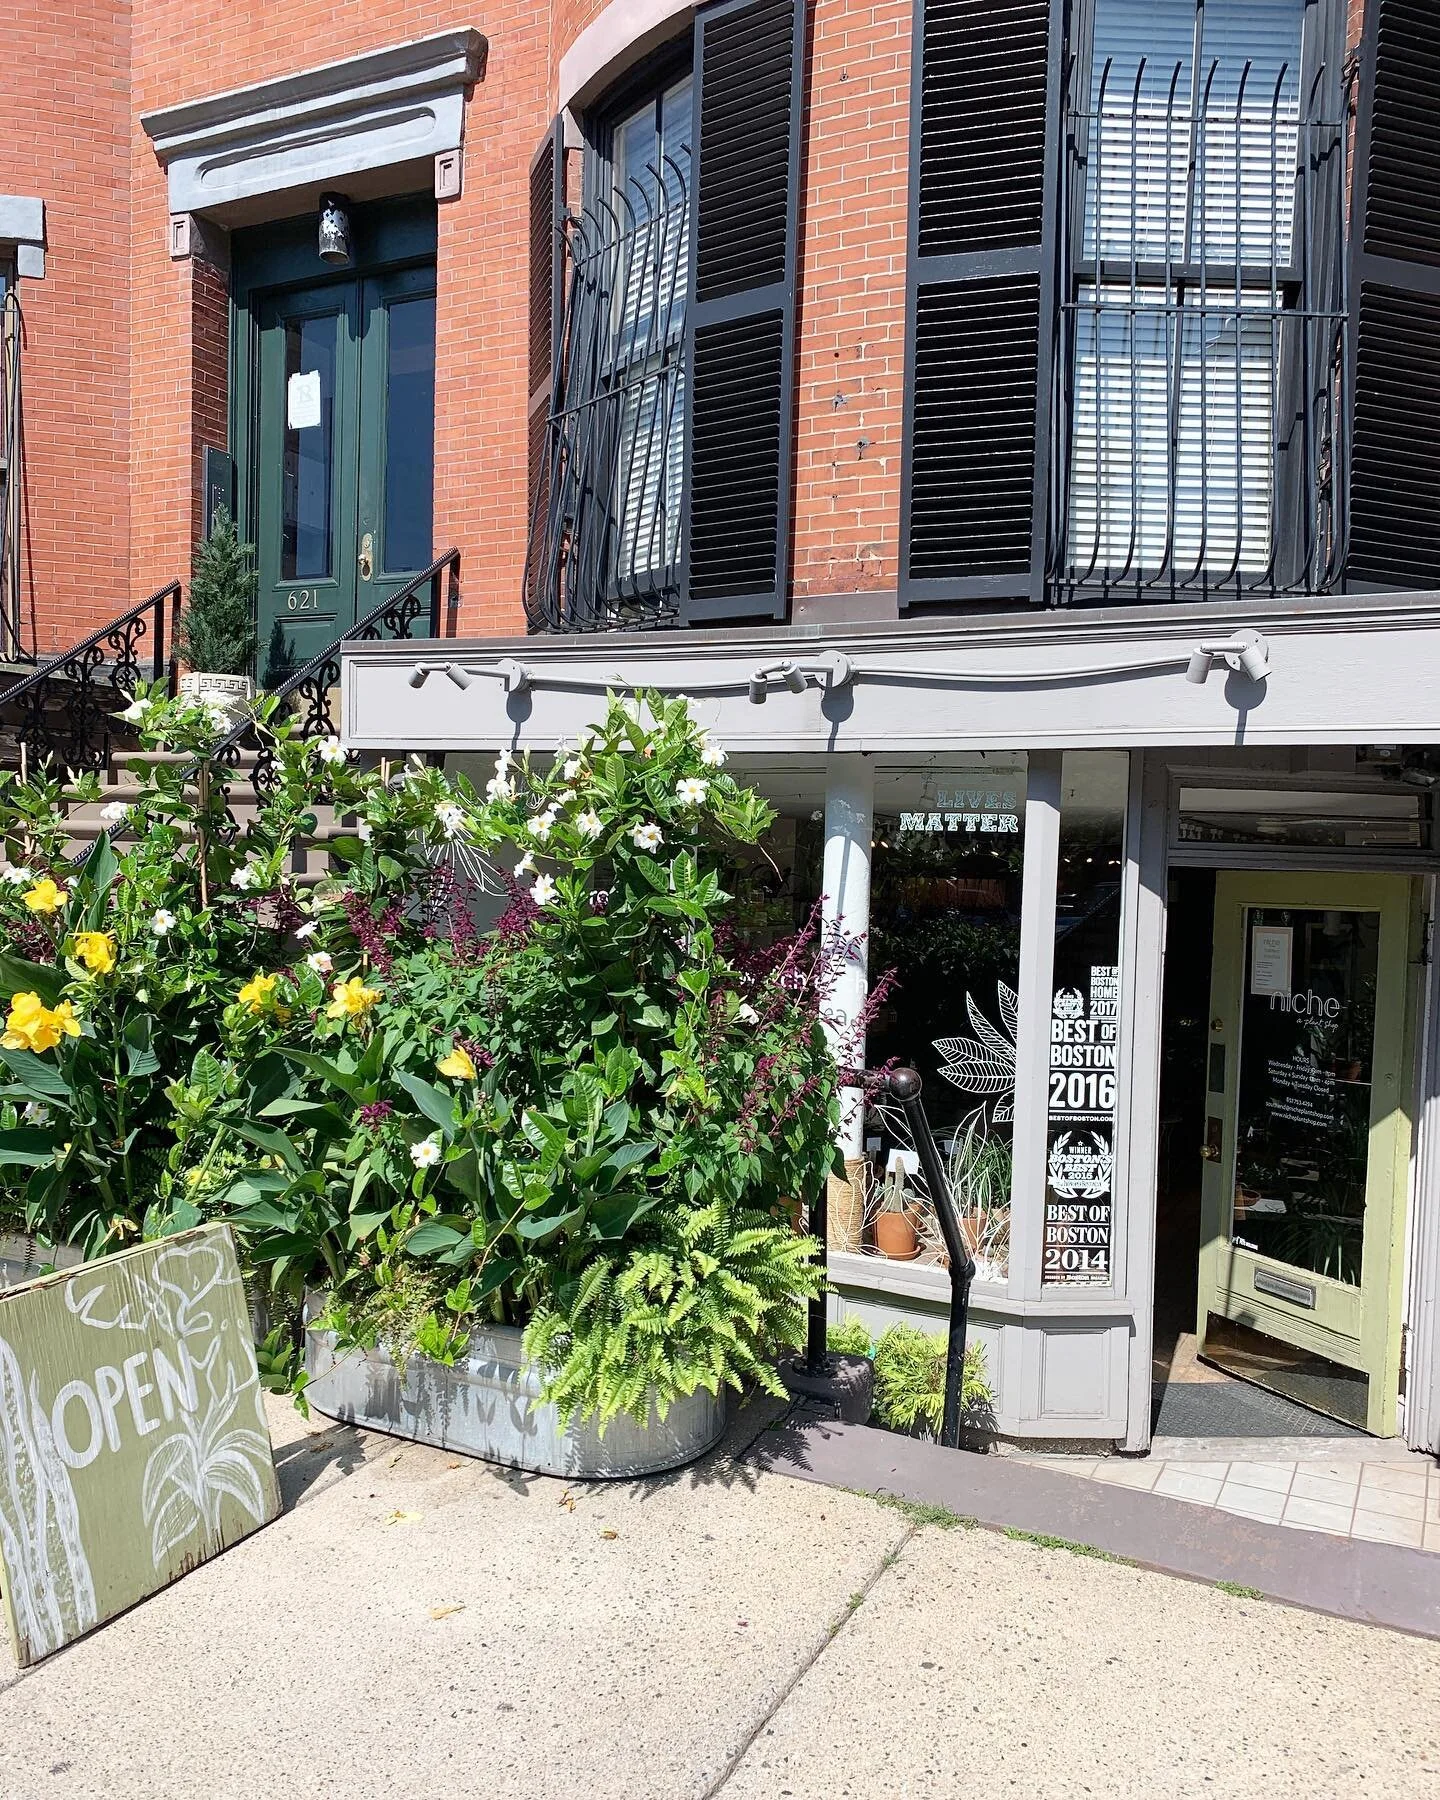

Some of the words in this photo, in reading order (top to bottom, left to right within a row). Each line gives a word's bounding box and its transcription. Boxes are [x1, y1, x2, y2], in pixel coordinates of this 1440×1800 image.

[288, 590, 317, 610] 621
[937, 791, 1016, 809] LIVES
[900, 813, 1018, 832] MATTER
[1091, 966, 1111, 976] BEST
[1091, 977, 1118, 986] BOSTON
[1090, 987, 1117, 998] HOME
[1090, 1001, 1117, 1015] 2017
[1270, 989, 1340, 1018] niche
[1304, 1016, 1323, 1029] plant
[1052, 1020, 1098, 1042] BEST
[1101, 1023, 1116, 1039] OF
[1051, 1045, 1116, 1066] BOSTON
[1292, 1056, 1309, 1064] HOURS
[1049, 1072, 1116, 1109] 2016
[1314, 1085, 1329, 1094] Closed
[1048, 1154, 1112, 1164] BOSTON'S
[1063, 1164, 1098, 1172] BEST
[1046, 1205, 1087, 1221] BEST
[1089, 1205, 1110, 1222] OF
[1045, 1227, 1109, 1243] BOSTON
[1044, 1249, 1108, 1270] 2014
[52, 1338, 199, 1469] OPEN
